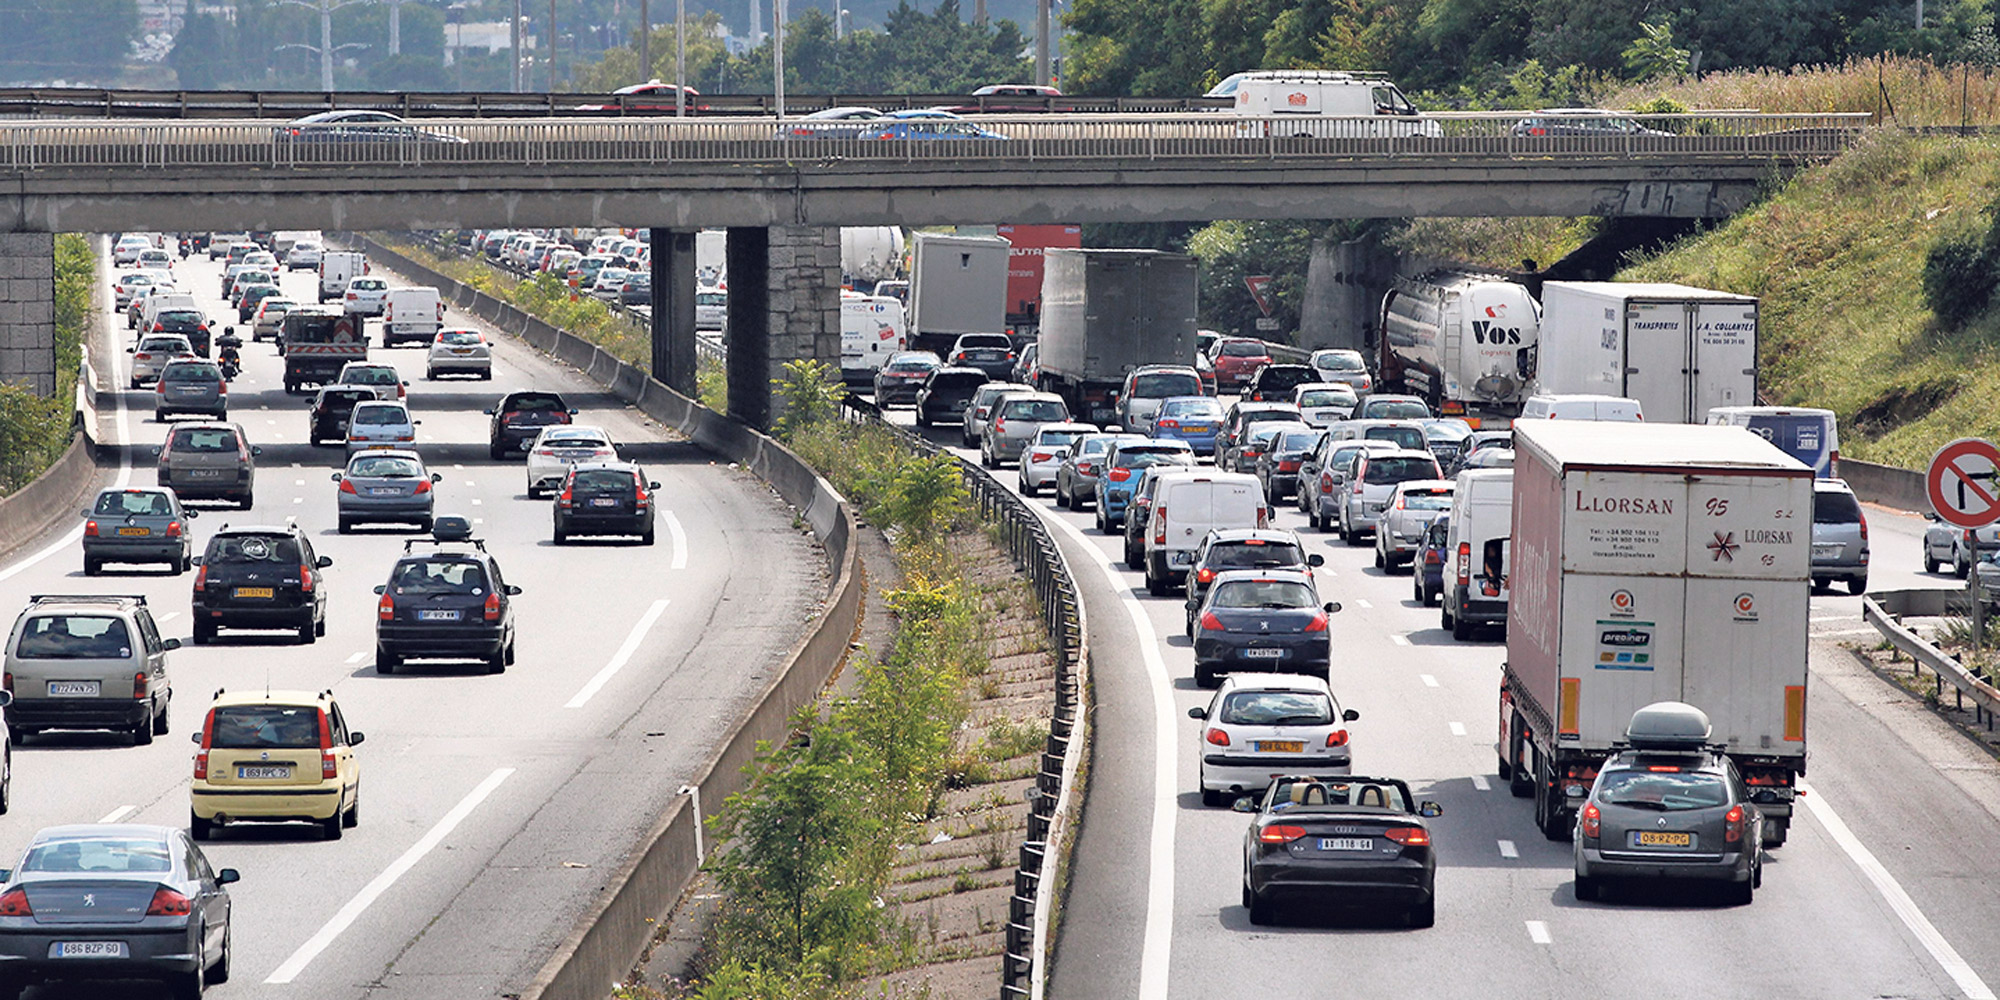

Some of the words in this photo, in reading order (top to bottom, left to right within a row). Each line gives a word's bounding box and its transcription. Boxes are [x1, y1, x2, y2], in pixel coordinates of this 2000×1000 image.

[1633, 322, 1679, 331] TRANSPORTES
[1714, 322, 1754, 332] COLLANTES
[1706, 497, 1729, 516] 95
[1744, 529, 1793, 544] LLORSAN
[1761, 554, 1775, 567] 95
